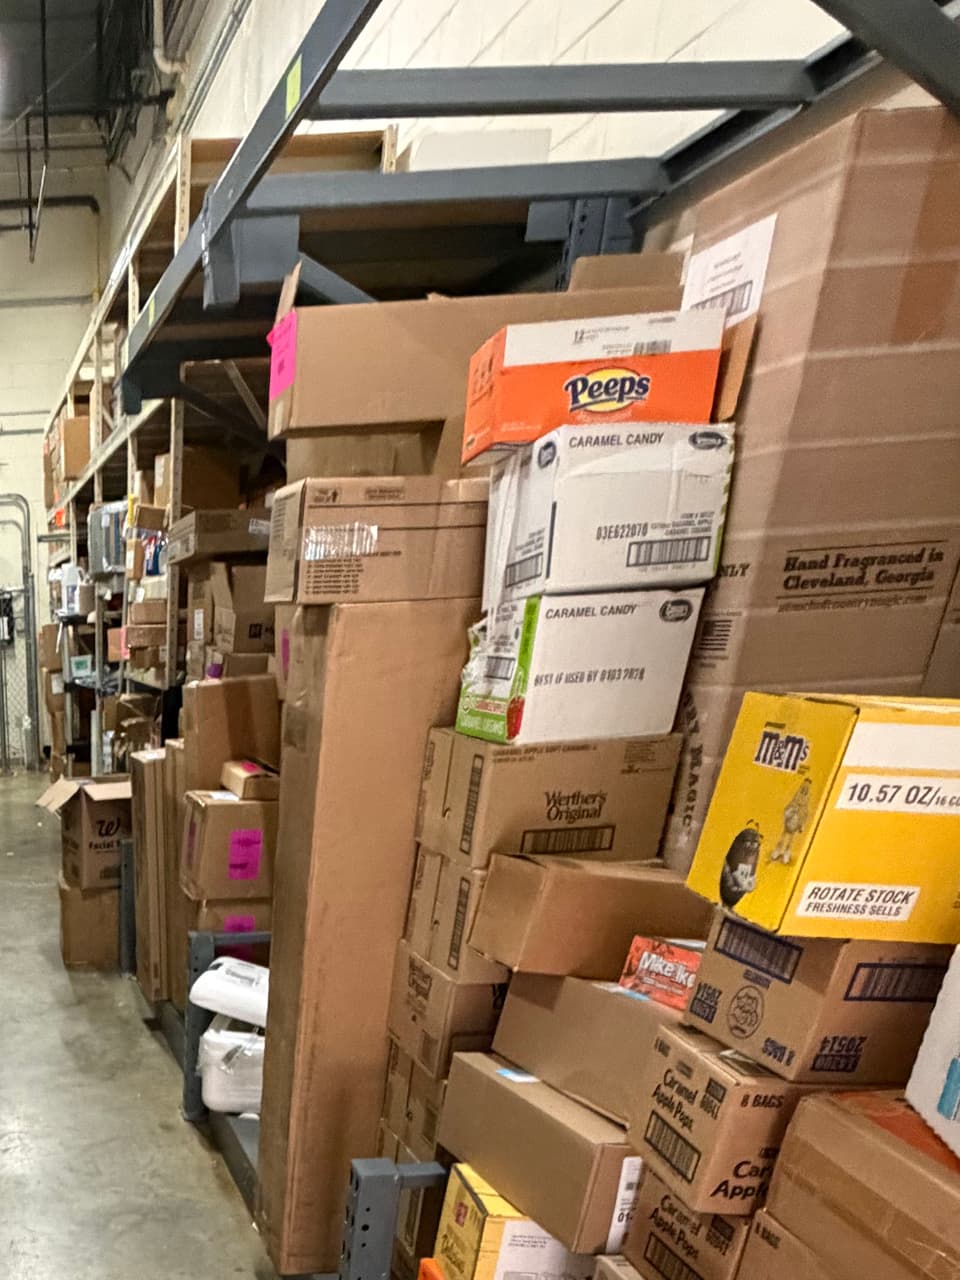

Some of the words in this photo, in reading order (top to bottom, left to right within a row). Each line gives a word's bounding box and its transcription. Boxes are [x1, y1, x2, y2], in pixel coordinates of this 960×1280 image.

[564, 375, 650, 404] Peeps
[569, 434, 623, 448] CARAMEL
[628, 432, 665, 445] CANDY
[784, 554, 828, 573] Hand
[833, 549, 925, 571] Fragranced
[929, 548, 944, 563] in
[783, 573, 869, 591] Cleveland,
[875, 568, 934, 587] Georgia
[545, 607, 597, 620] CARAMEL
[601, 604, 638, 616] CANDY
[534, 673, 553, 686] BEST
[555, 672, 562, 685] IF
[565, 671, 585, 684] USED
[587, 670, 598, 683] BY
[545, 790, 608, 807] Werther's
[848, 783, 901, 802] 10.57
[547, 804, 602, 824] Original
[808, 887, 863, 902] ROTATE
[867, 888, 915, 905] STOCK
[805, 902, 867, 916] FRESHNESS
[869, 904, 902, 917] SELLS
[640, 951, 674, 977] Mike
[821, 1036, 867, 1056] 20514
[663, 1068, 699, 1105] Caramel
[651, 1084, 675, 1111] Apple
[740, 1095, 748, 1107] 8
[753, 1093, 786, 1108] BAGS
[733, 1160, 774, 1179] Car
[710, 1180, 769, 1200] Appl
[649, 1207, 677, 1235] Apple
[660, 1194, 702, 1237] Caramel
